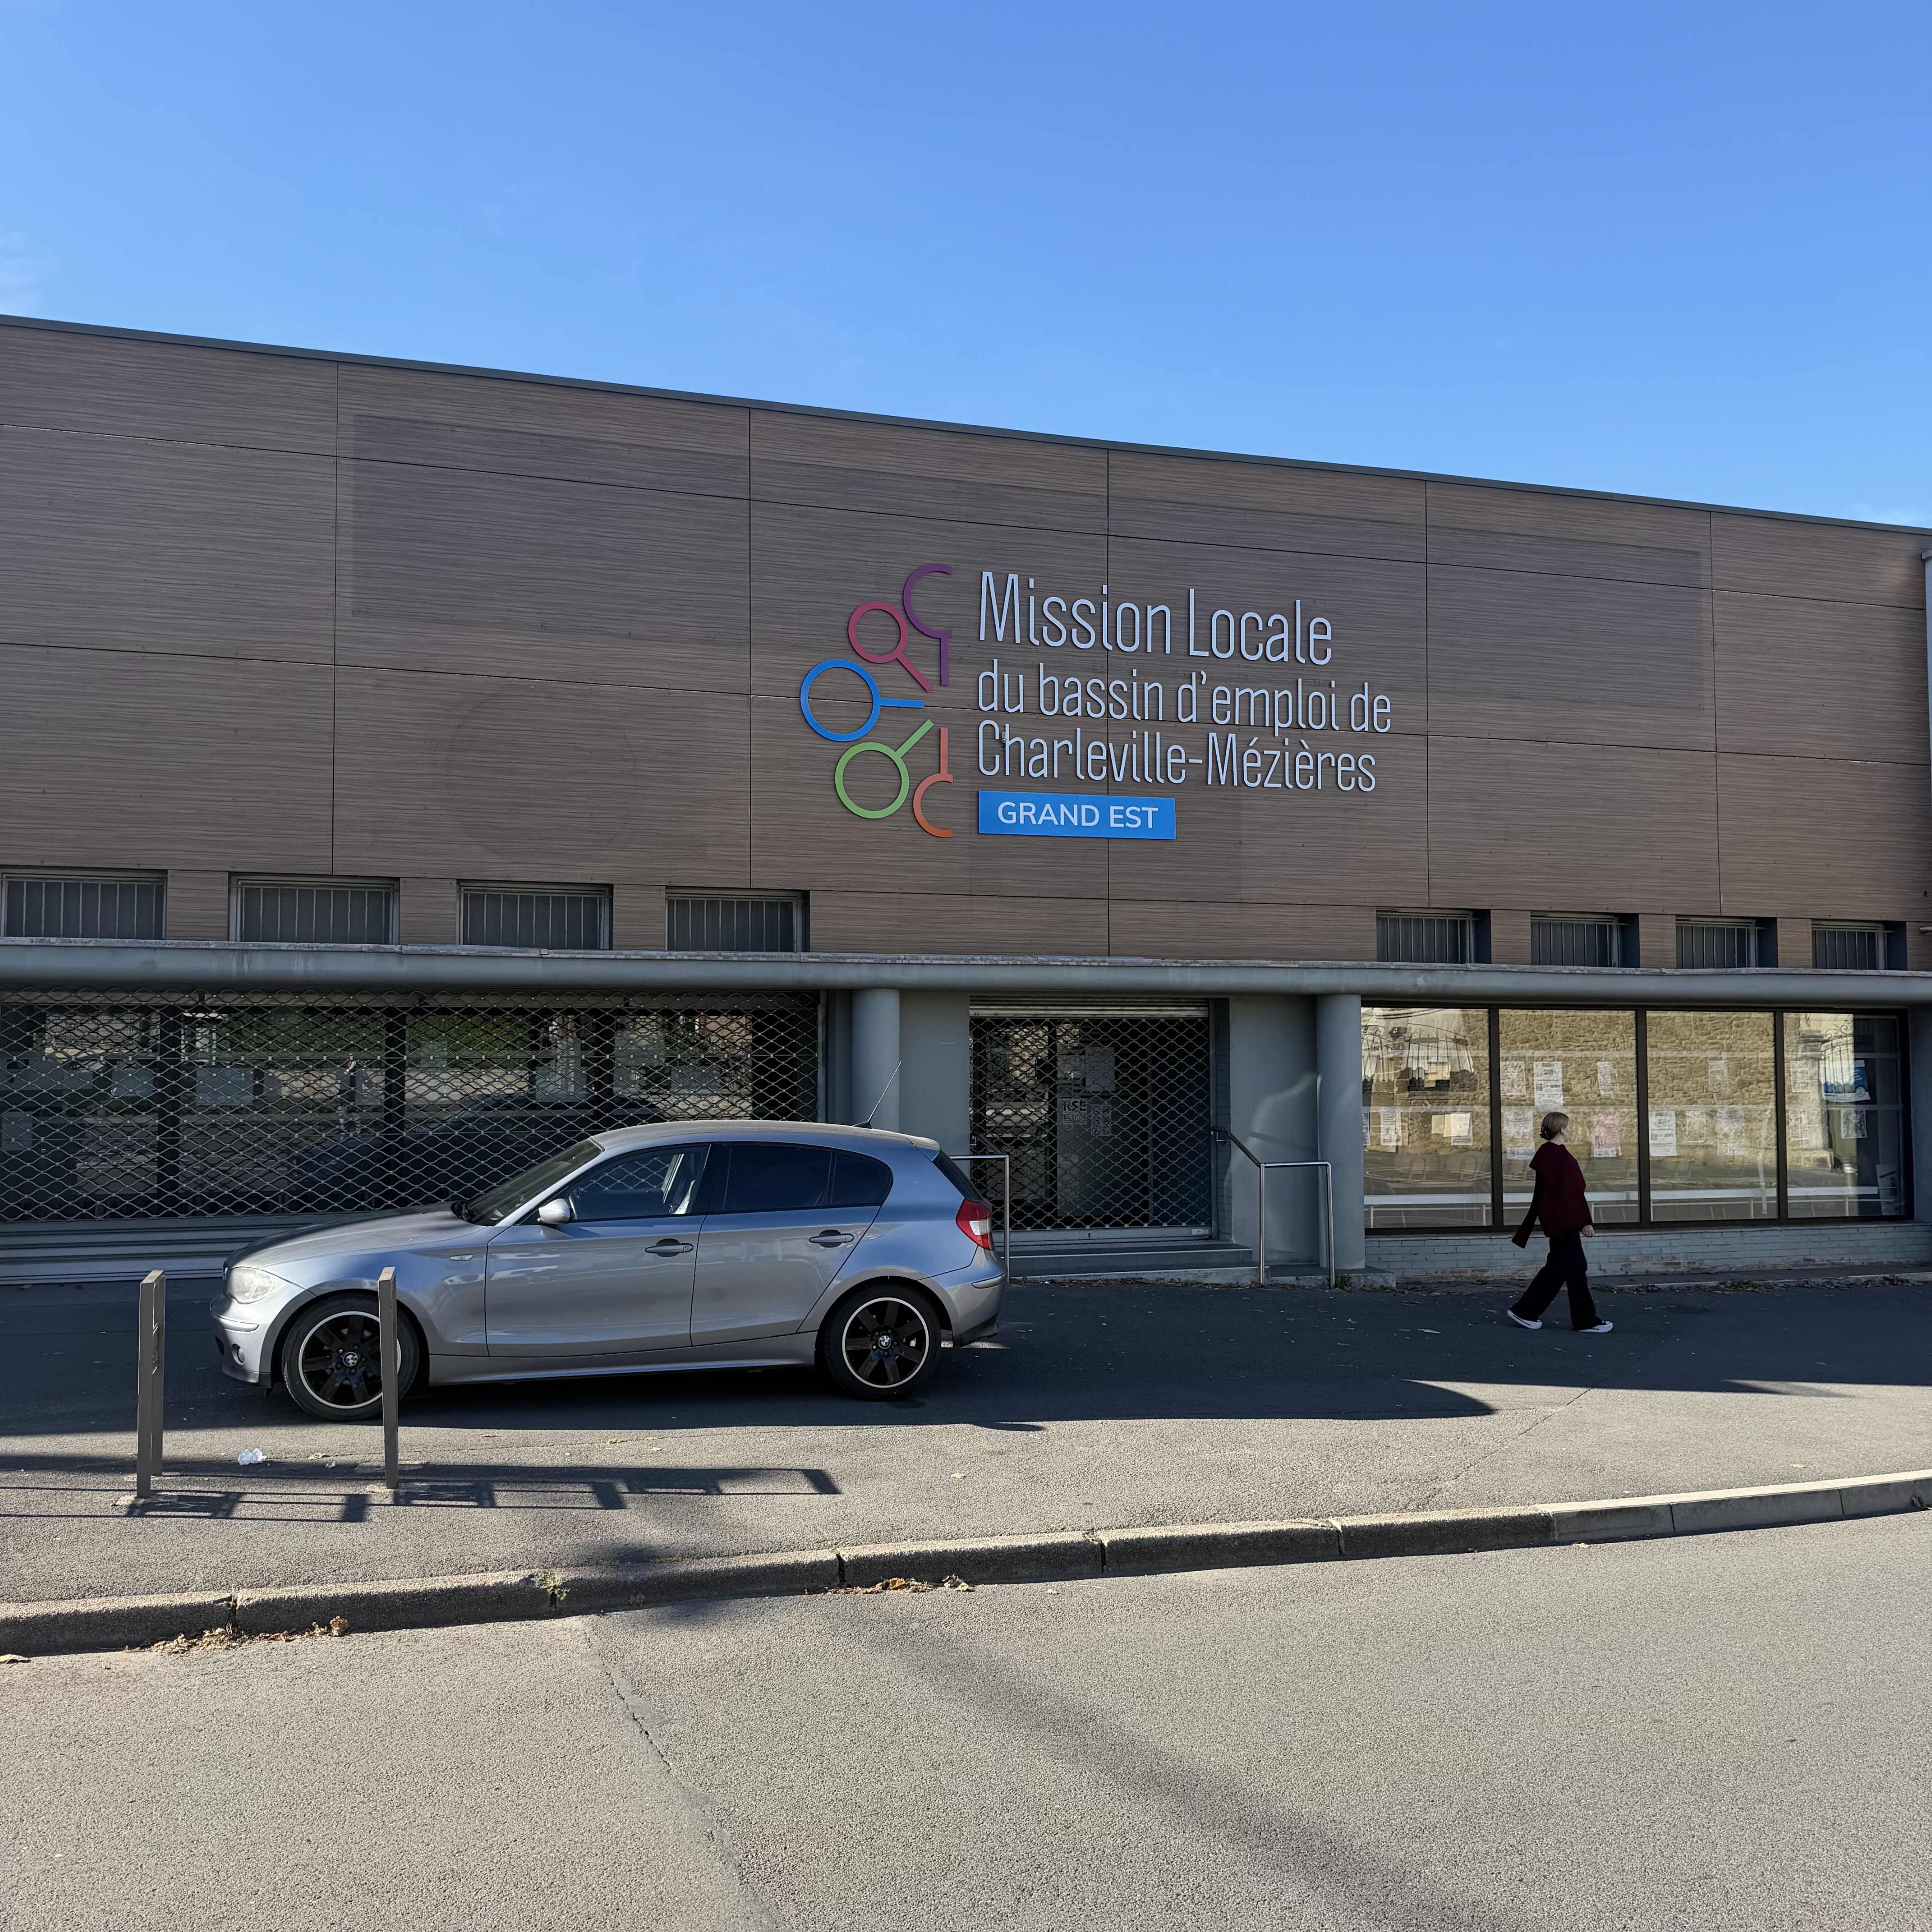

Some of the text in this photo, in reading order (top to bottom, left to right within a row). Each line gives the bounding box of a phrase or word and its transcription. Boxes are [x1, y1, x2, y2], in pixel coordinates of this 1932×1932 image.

[979, 570, 1332, 666] Mission Locale
[978, 658, 1391, 736] du bassin d'emploi de
[978, 719, 1376, 792] Charleville-Mézières
[998, 801, 1159, 829] GRAND EST
